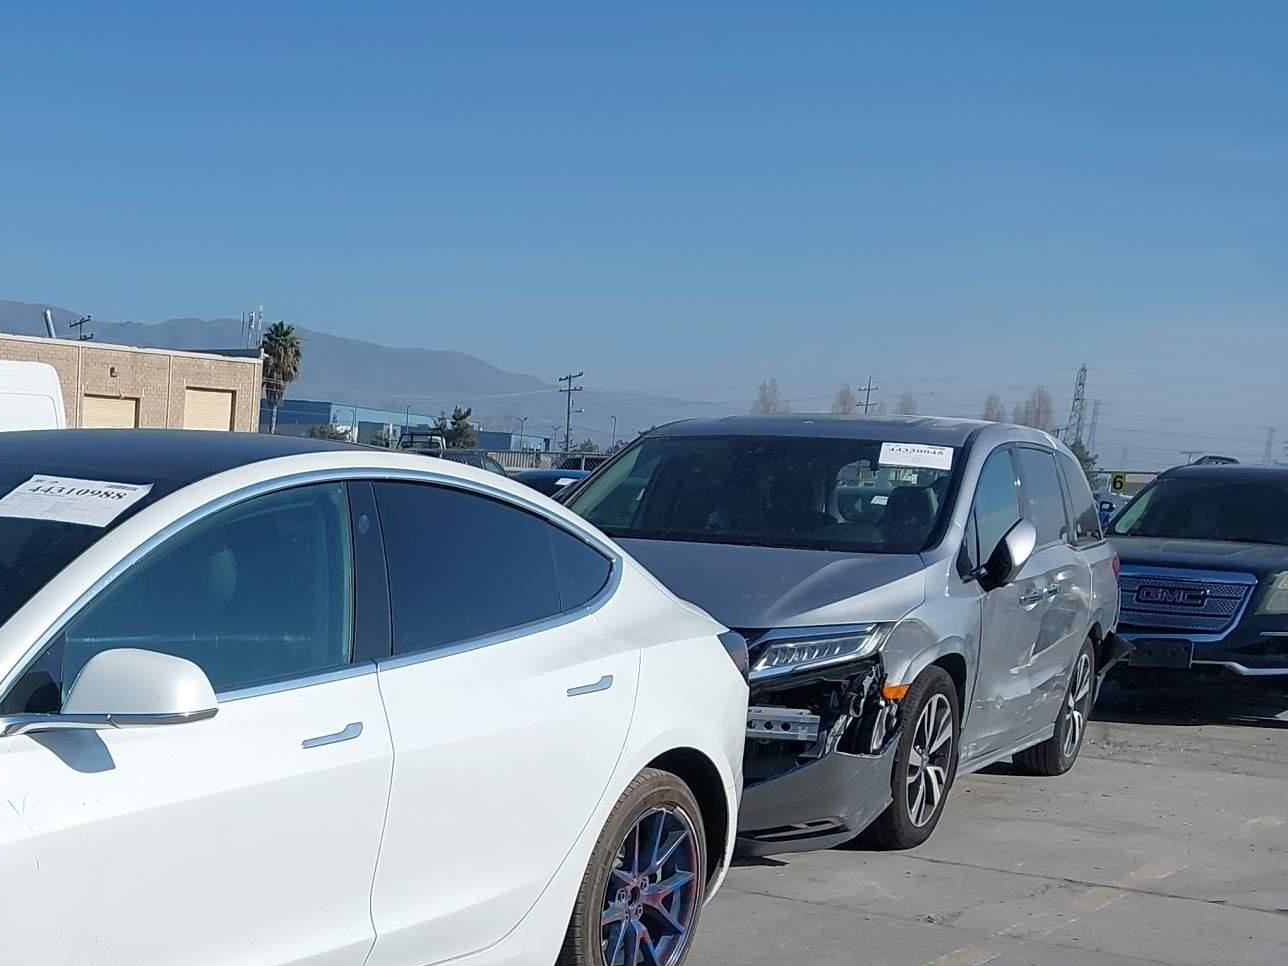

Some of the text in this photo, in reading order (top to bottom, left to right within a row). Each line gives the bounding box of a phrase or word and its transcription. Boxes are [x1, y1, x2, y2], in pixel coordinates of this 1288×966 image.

[1112, 474, 1124, 491] 6
[29, 485, 128, 500] 44310988
[1138, 588, 1204, 604] GMC
